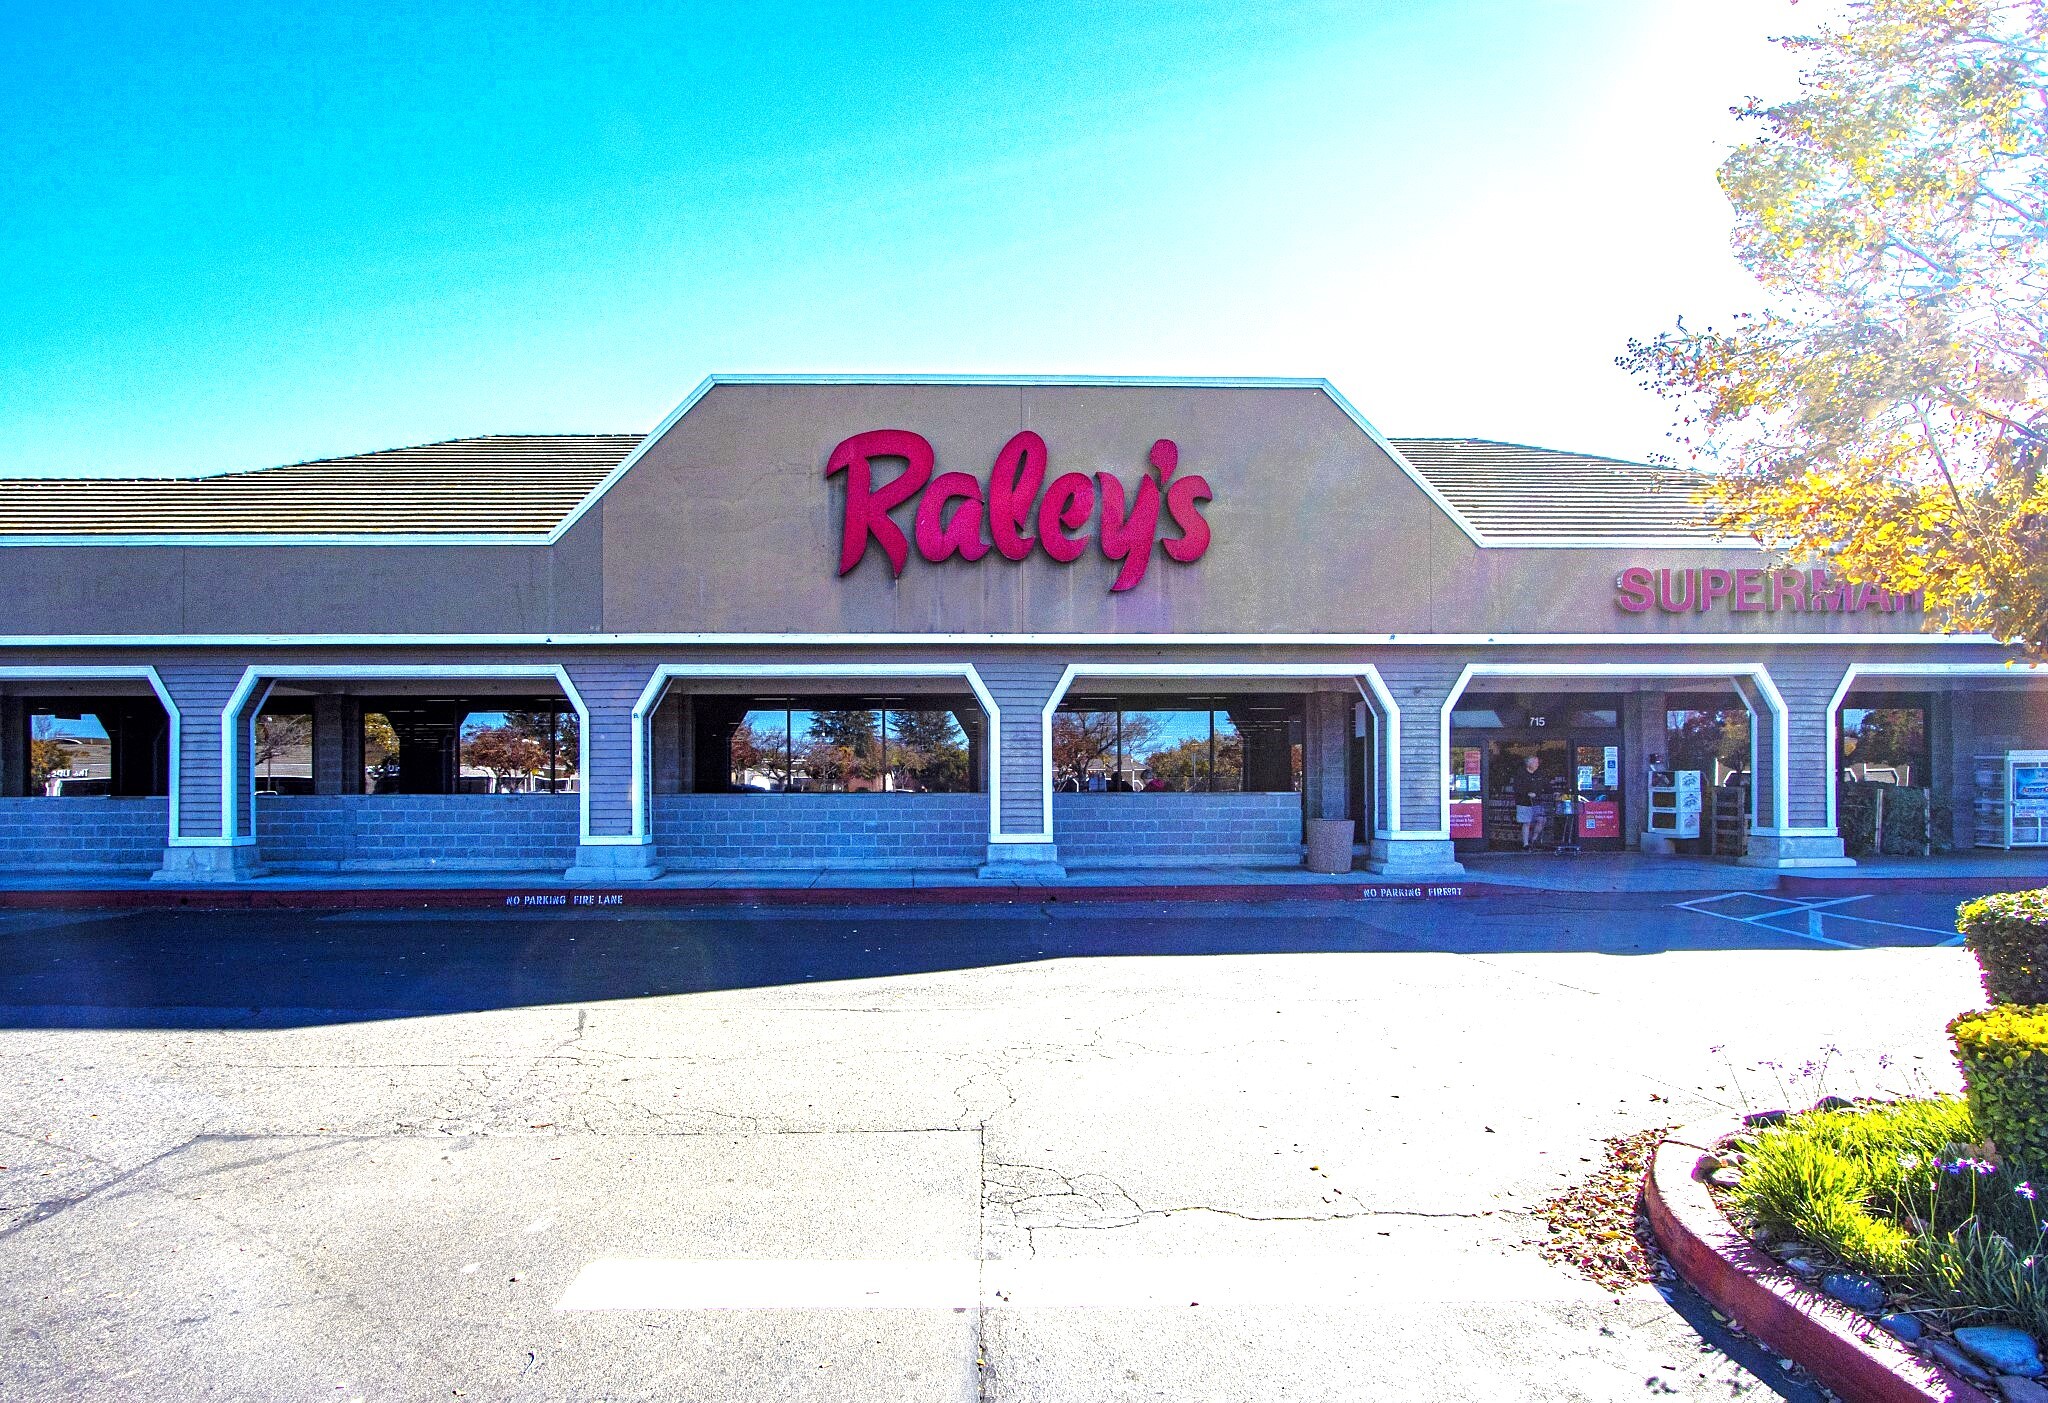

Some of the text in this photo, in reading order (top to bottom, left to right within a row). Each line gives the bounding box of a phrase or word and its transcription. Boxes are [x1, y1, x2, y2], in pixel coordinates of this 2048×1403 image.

[825, 429, 1213, 592] Raley's
[1529, 717, 1545, 727] 715
[1363, 888, 1377, 898] NO
[1380, 887, 1422, 897] PARKING
[506, 895, 623, 905] NO PARKING FIRE LANE
